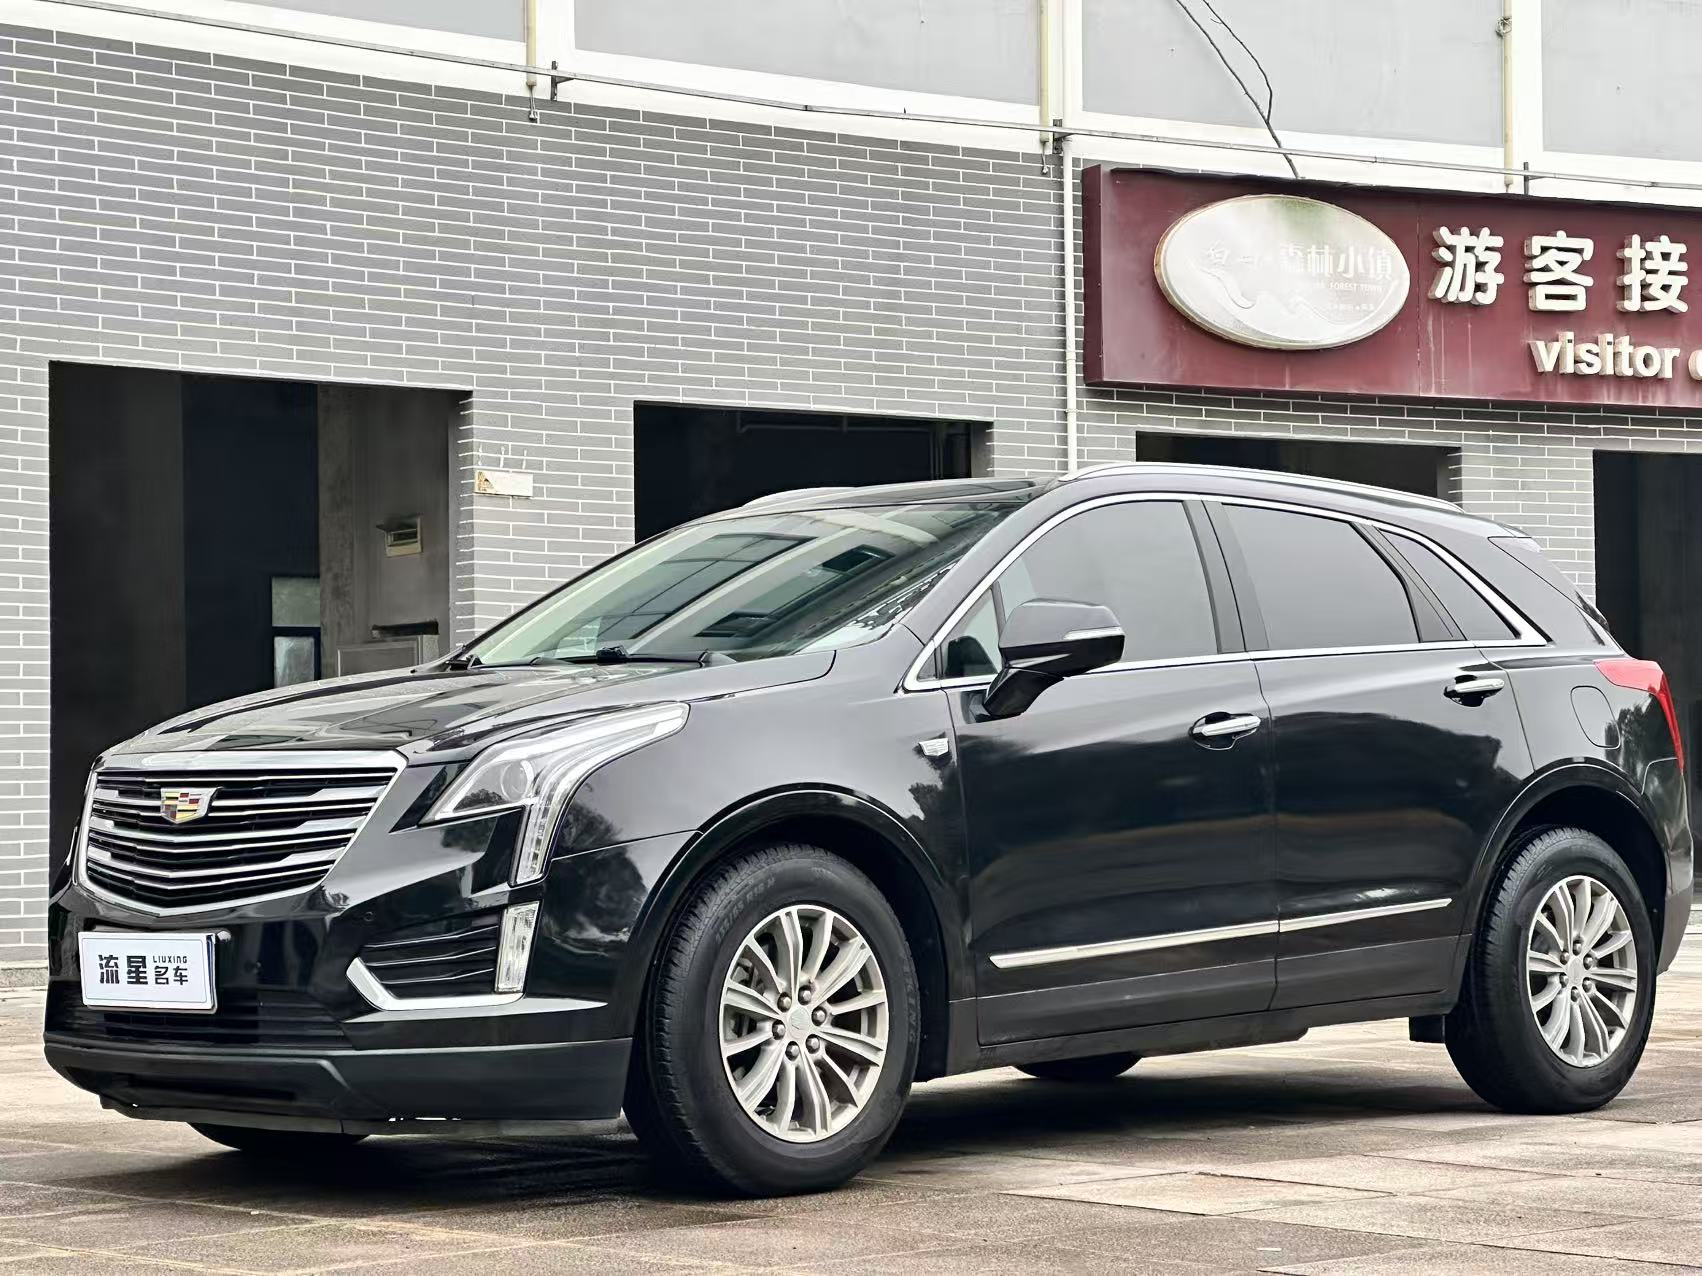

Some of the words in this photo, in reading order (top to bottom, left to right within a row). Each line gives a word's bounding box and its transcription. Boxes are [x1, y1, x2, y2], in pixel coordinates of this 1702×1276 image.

[1428, 226, 1688, 313] 游客接
[1528, 331, 1680, 379] visitor
[98, 954, 148, 985] 流星
[153, 955, 187, 963] LIUXING
[154, 965, 188, 985] 名车
